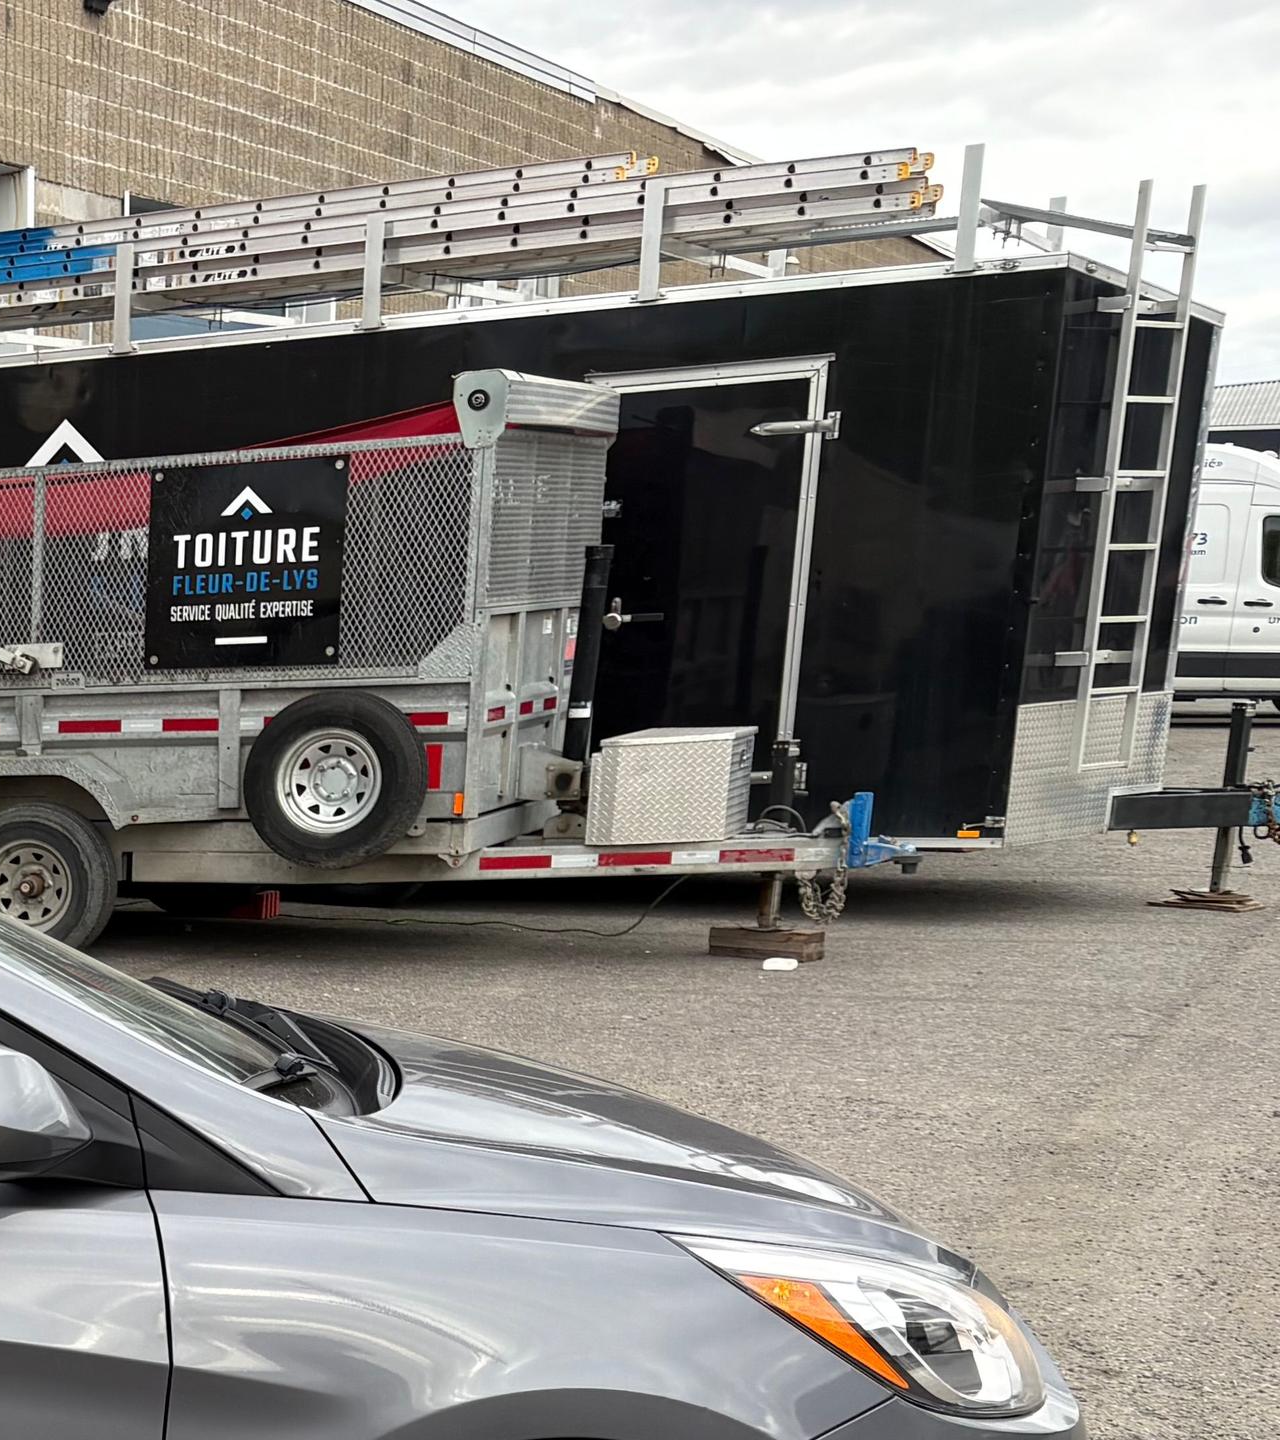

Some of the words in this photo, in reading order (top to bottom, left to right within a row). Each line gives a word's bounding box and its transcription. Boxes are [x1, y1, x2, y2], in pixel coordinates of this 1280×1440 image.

[173, 526, 320, 569] TOITURE
[172, 567, 319, 596] FLEUR-DE-LYS
[170, 603, 211, 622] SERVICE
[215, 599, 256, 621] QUALITÉ
[260, 600, 314, 618] EXPERTISE
